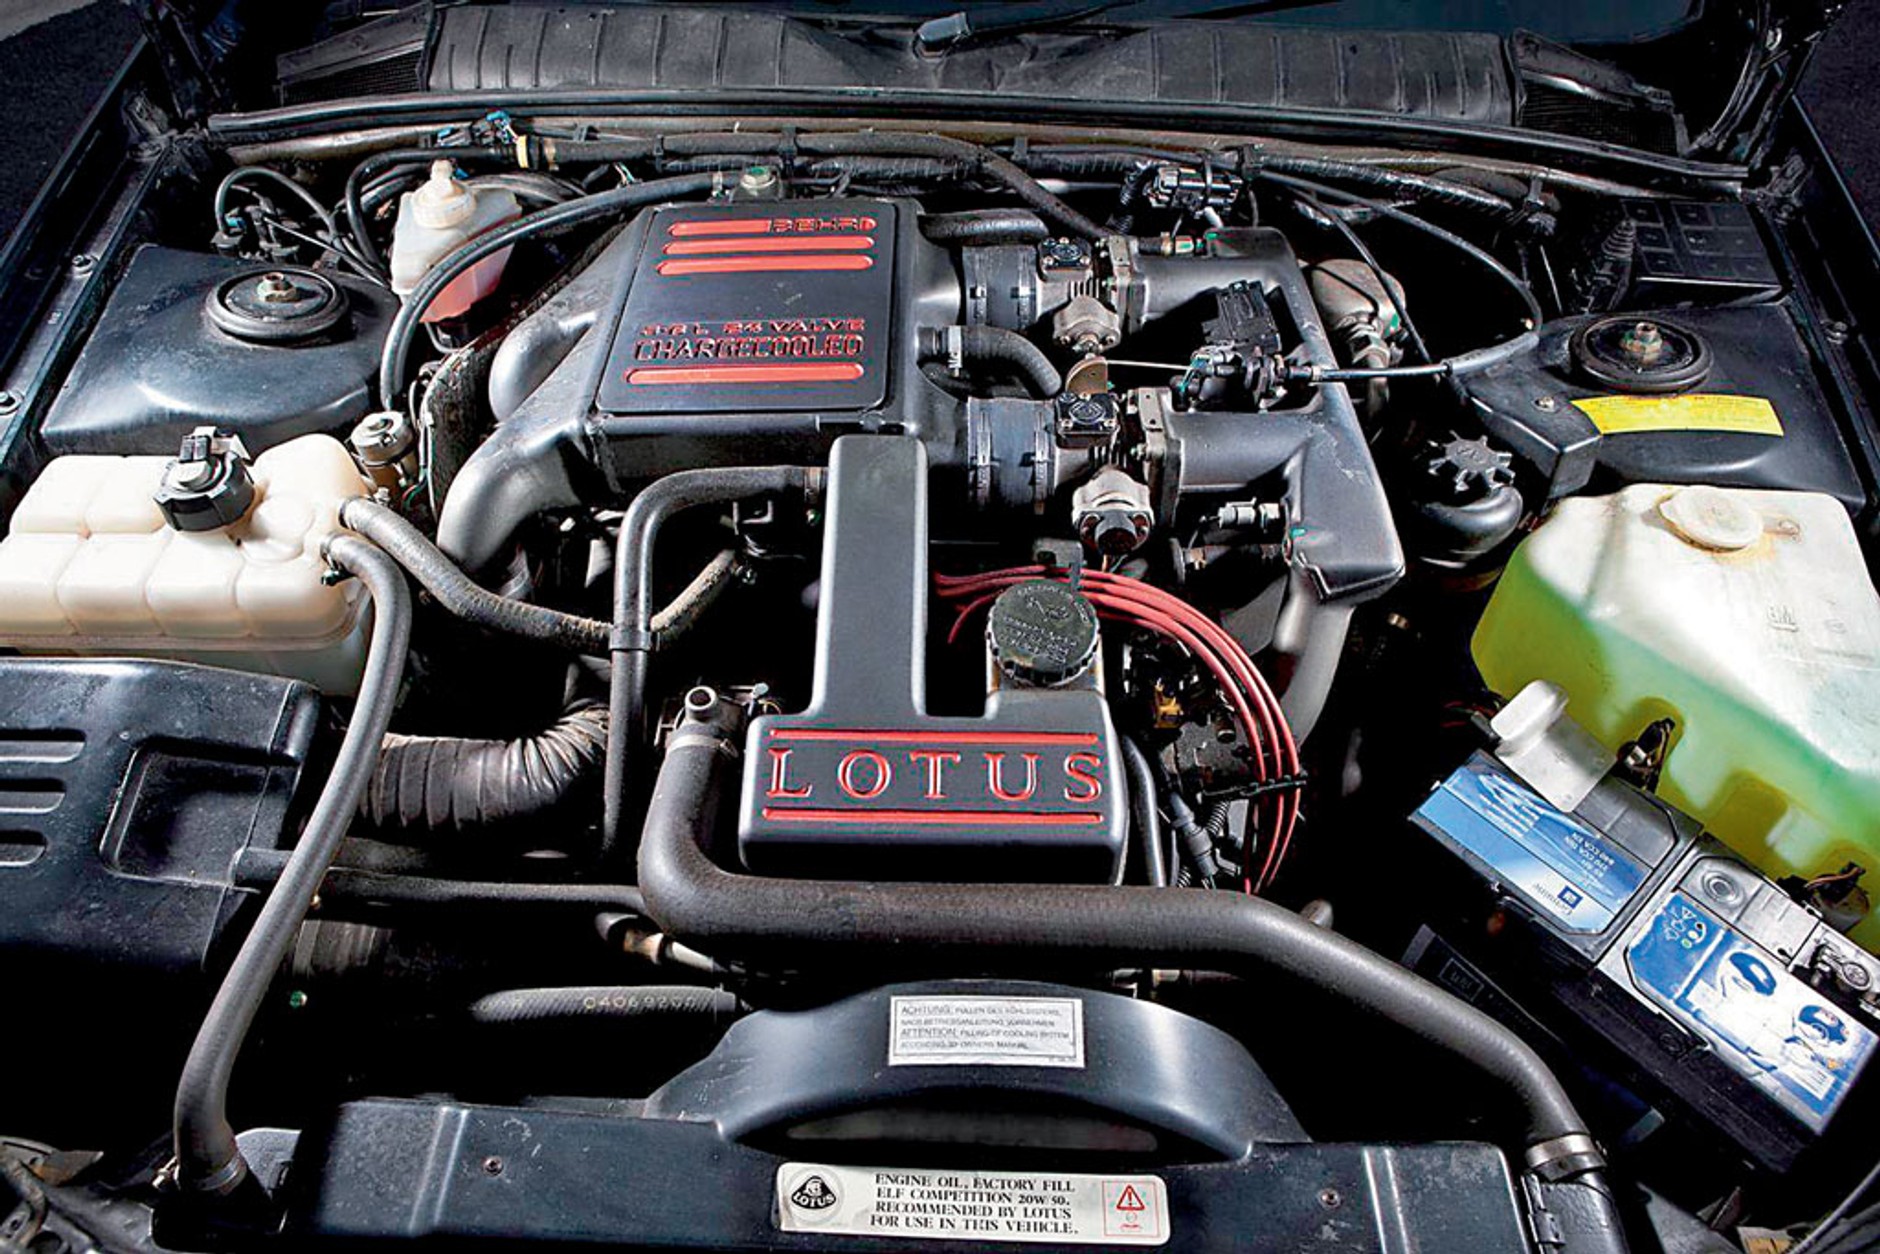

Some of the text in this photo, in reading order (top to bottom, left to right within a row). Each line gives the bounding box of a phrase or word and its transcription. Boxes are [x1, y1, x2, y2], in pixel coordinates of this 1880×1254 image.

[770, 218, 859, 232] BEHR
[769, 317, 866, 333] VALVE
[633, 333, 865, 362] CHARGECOOLED
[765, 748, 1103, 802] LOTUS
[875, 1173, 932, 1187] ENGINE
[972, 1177, 1037, 1191] FACTORY
[1042, 1180, 1075, 1192] FILL
[792, 1191, 836, 1208] LOTUS
[876, 1187, 905, 1199] ELF
[910, 1189, 1013, 1204] COMPETITION
[875, 1200, 1072, 1220] RECOMMENDED BY LOTUS
[870, 1214, 1079, 1235] FOR USE IN THIS VEHICLE.
